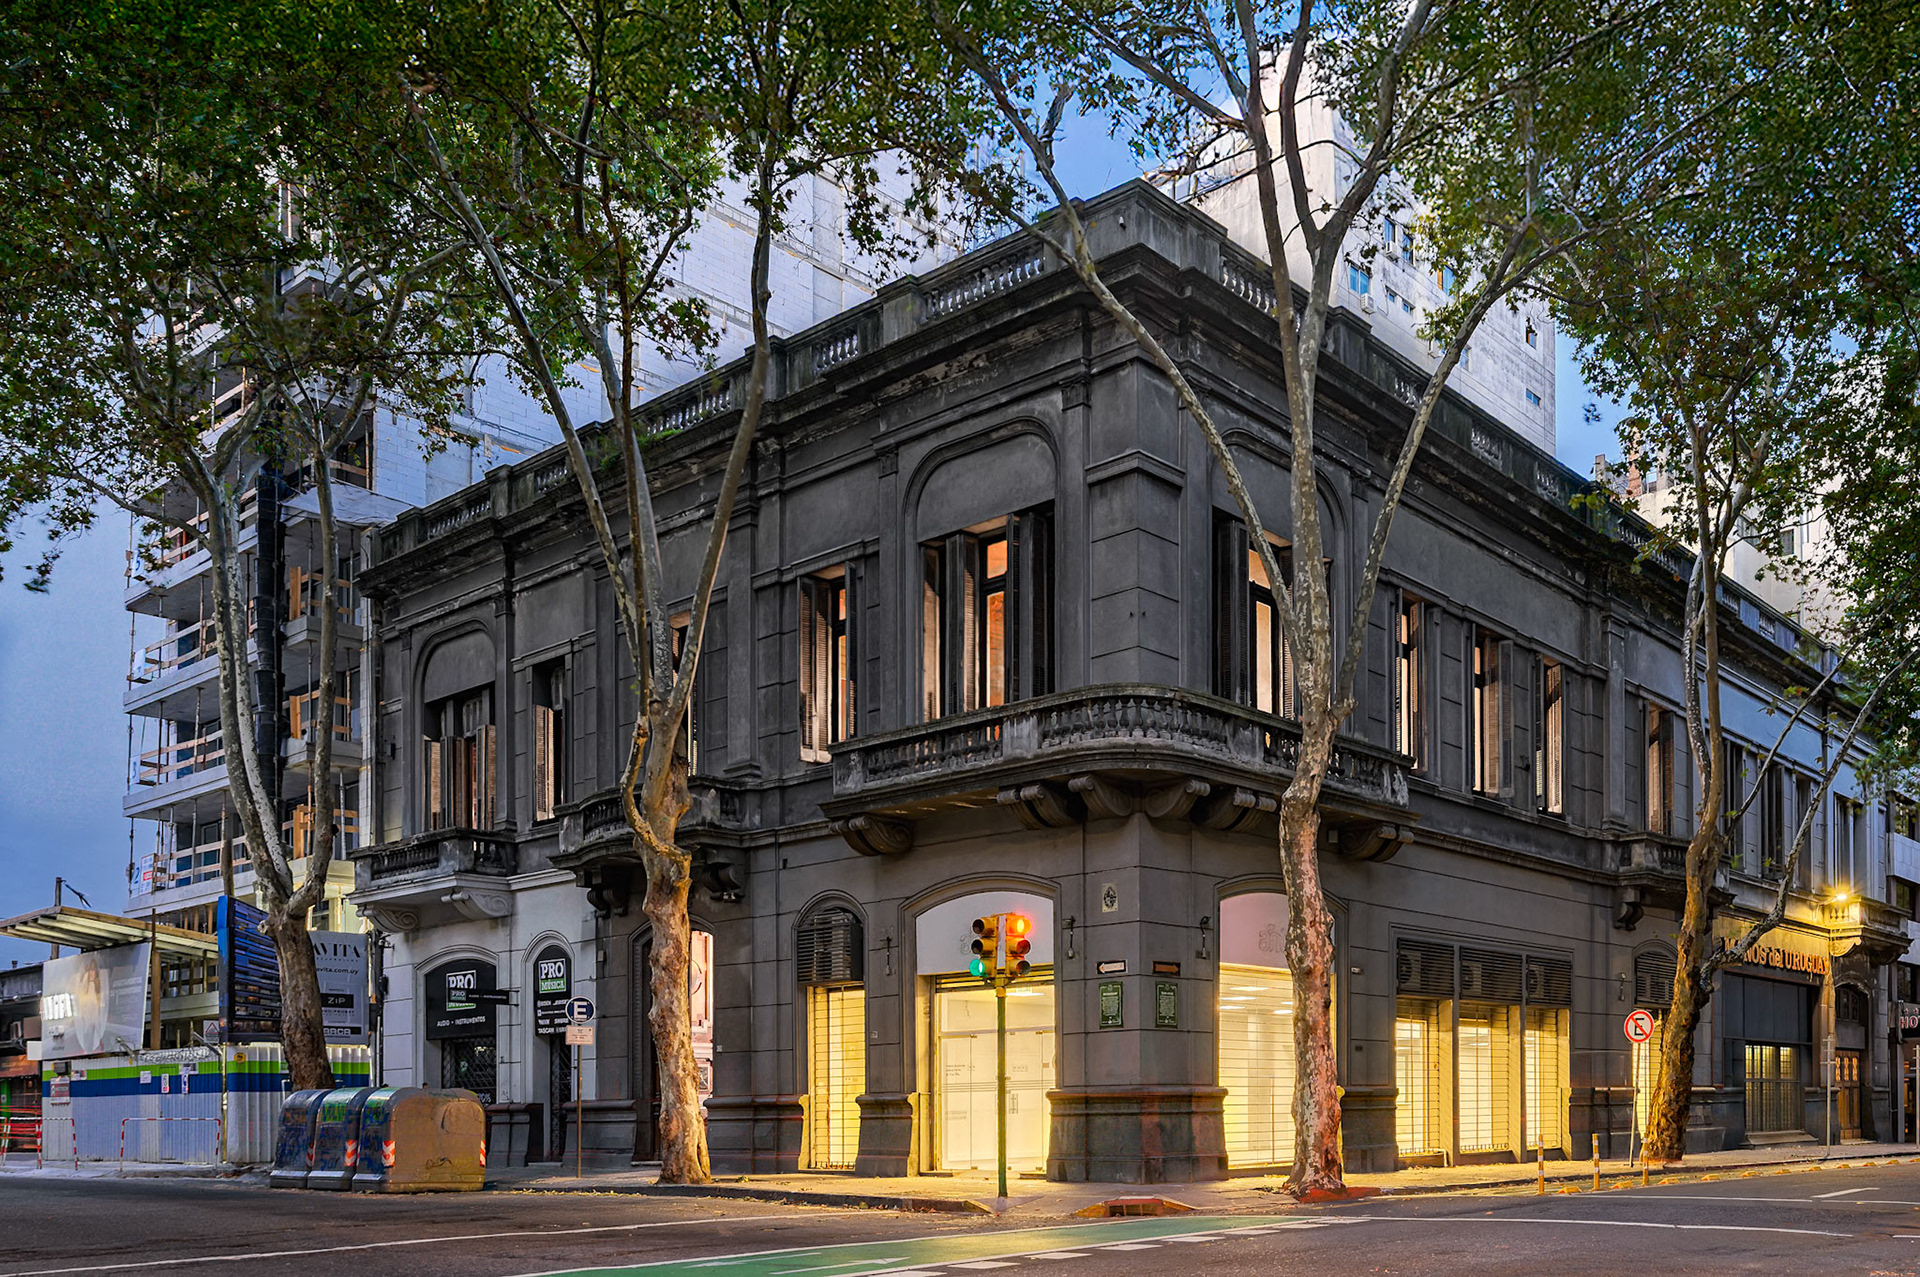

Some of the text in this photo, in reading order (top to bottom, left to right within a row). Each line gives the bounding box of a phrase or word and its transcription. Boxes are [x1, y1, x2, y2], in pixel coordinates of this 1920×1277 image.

[1769, 947, 1784, 968] del
[1785, 951, 1829, 975] URUGUAY
[541, 962, 564, 979] PRO
[448, 974, 474, 989] PRO
[574, 1001, 587, 1018] E
[1634, 1018, 1645, 1035] E
[1900, 1016, 1920, 1028] HO
